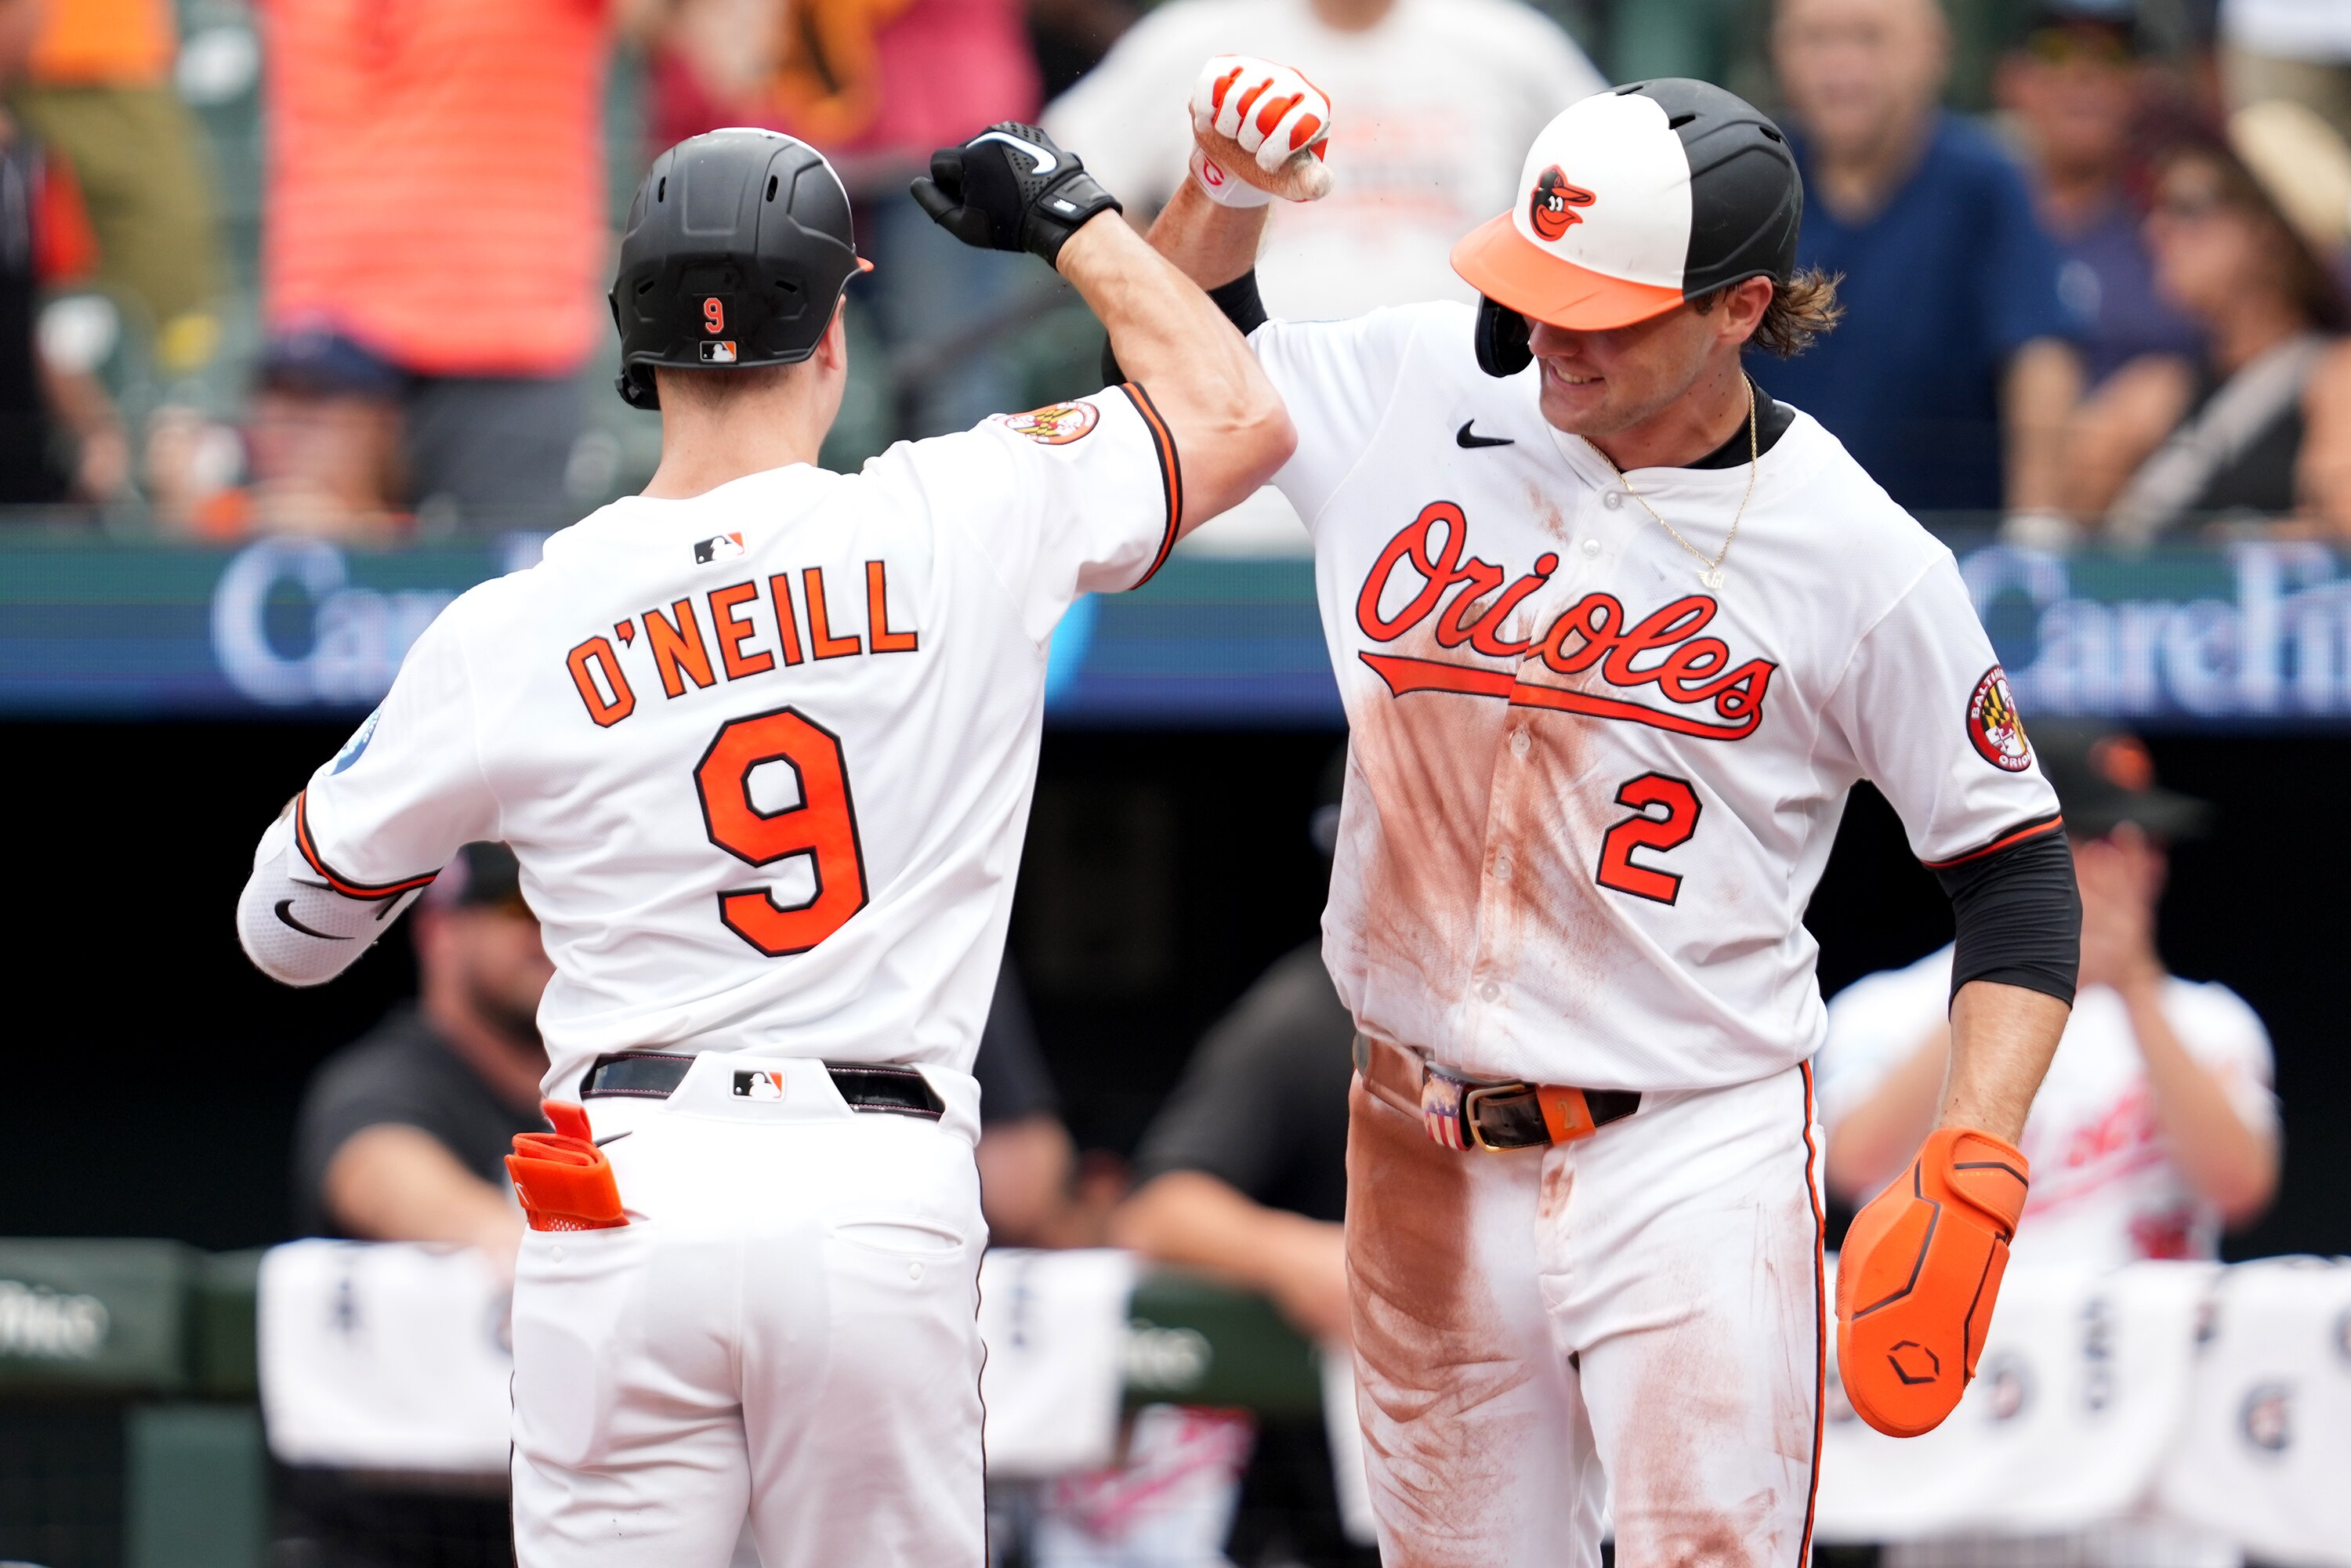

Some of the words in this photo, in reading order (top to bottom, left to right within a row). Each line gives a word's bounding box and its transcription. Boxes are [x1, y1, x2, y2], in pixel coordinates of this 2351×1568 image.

[703, 297, 724, 334] 9
[566, 559, 918, 728] O'NEILL
[1356, 500, 1780, 741] Orioles
[693, 706, 869, 958] 9
[1596, 770, 1703, 906] 2
[1556, 1099, 1577, 1129] 2
